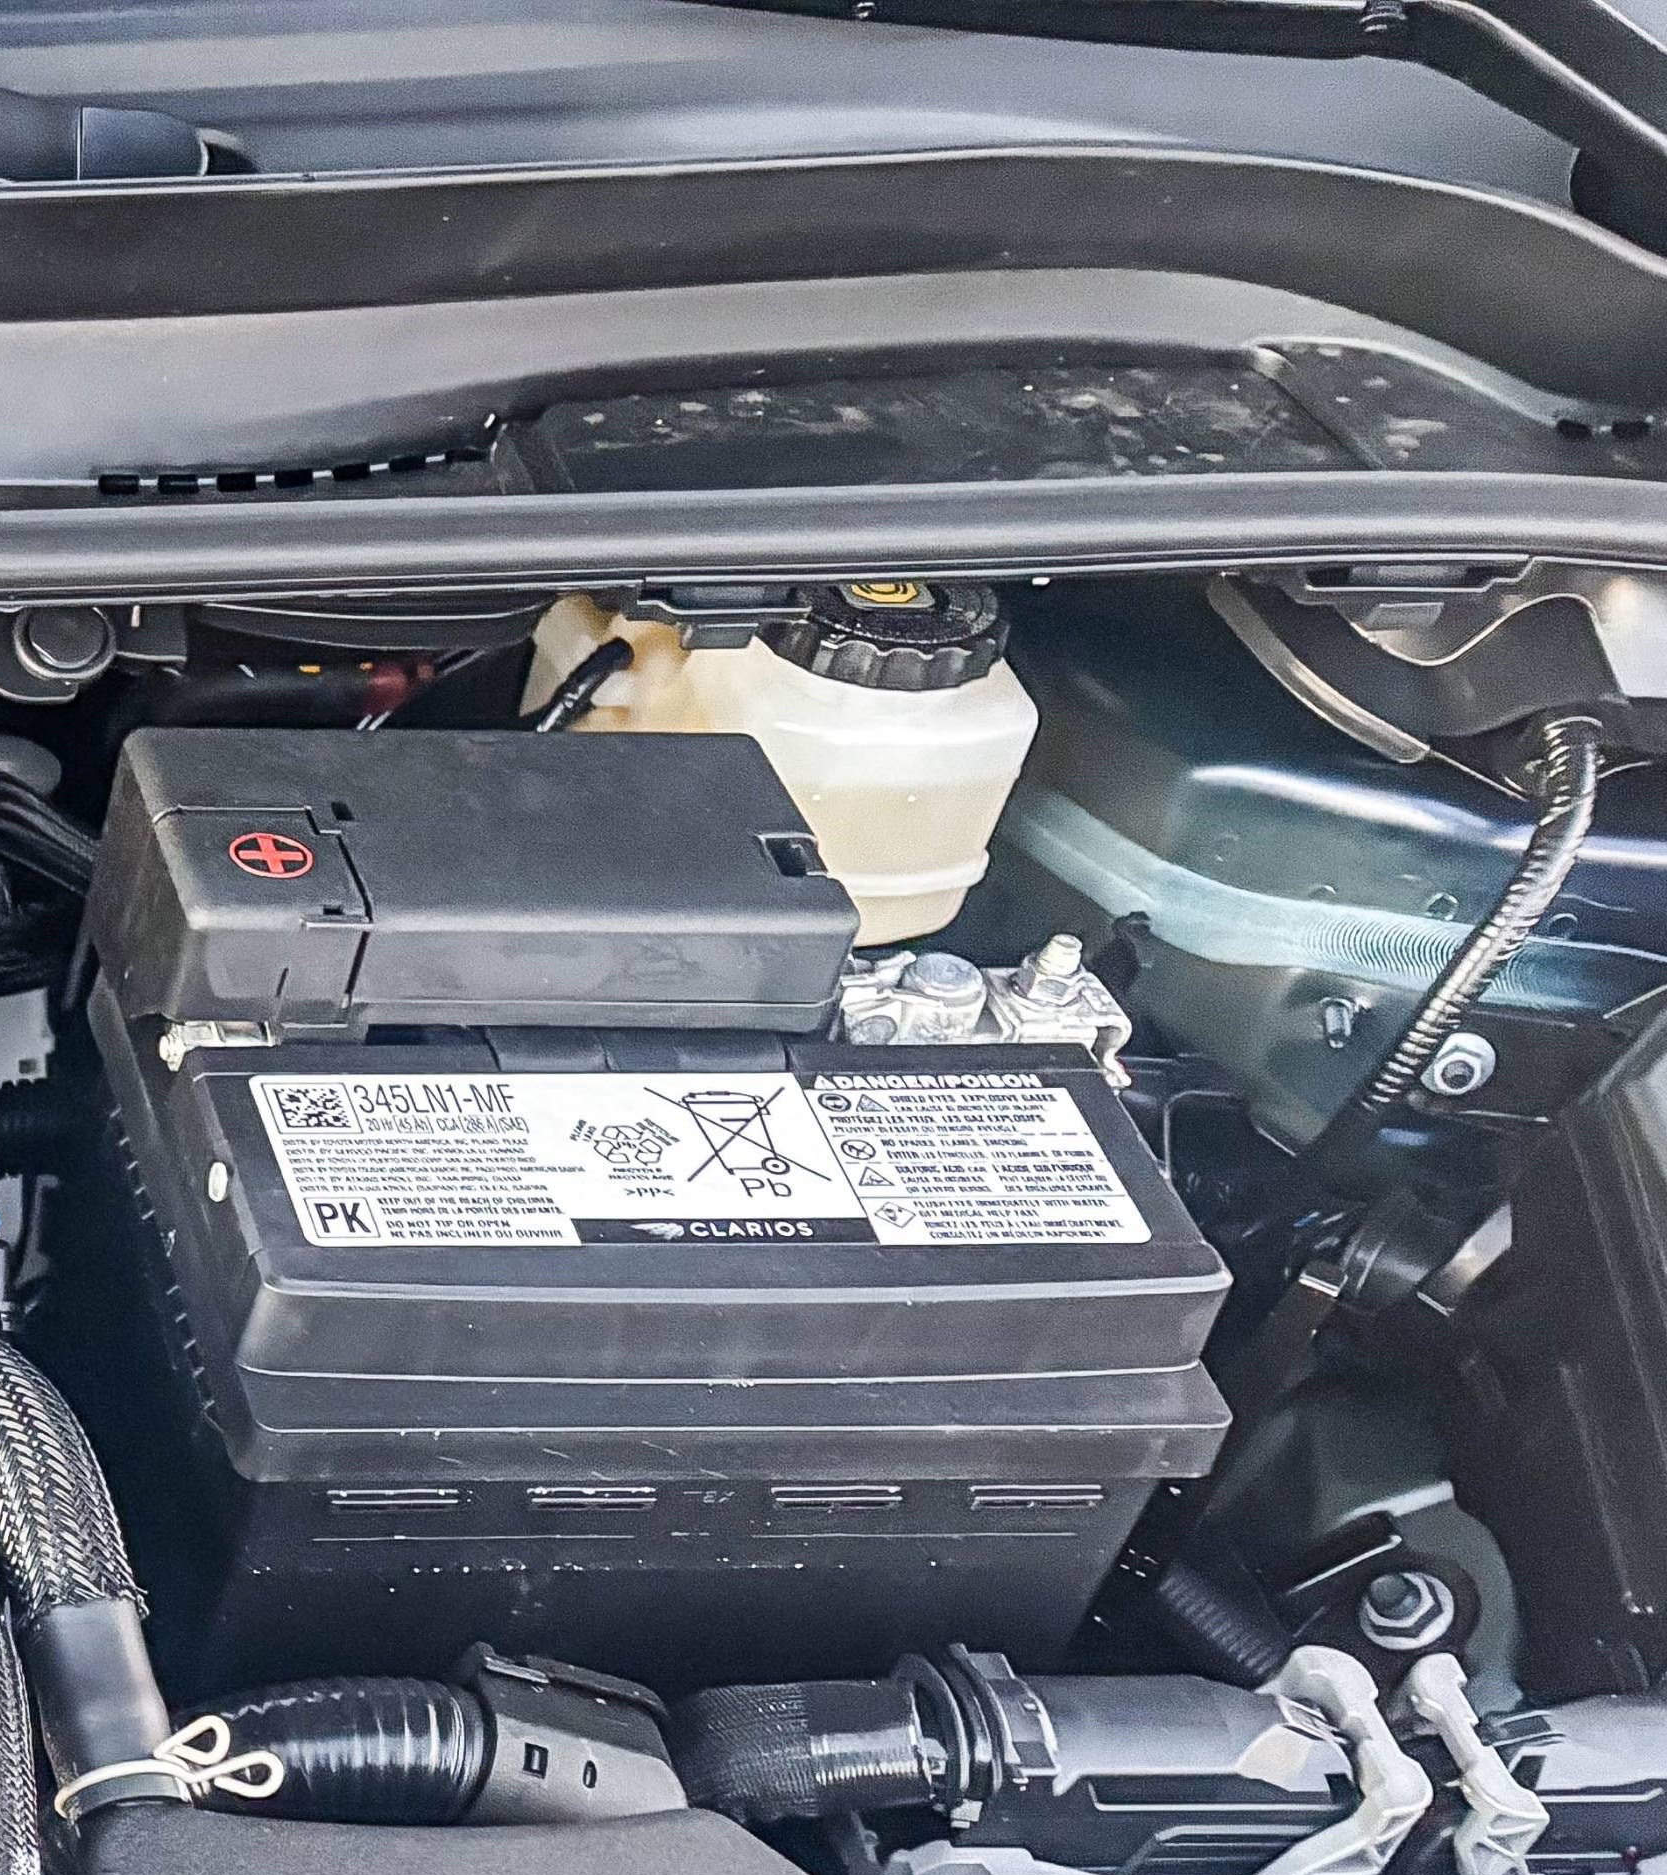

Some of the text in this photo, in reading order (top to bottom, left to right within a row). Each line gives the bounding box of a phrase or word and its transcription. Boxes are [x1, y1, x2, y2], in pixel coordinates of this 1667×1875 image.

[832, 1074, 1043, 1089] DANGER/POISON
[353, 1084, 515, 1113] 345LN1-MF
[740, 1178, 792, 1198] Pb
[314, 1203, 371, 1233] PK
[690, 1222, 815, 1238] CLARIOS
